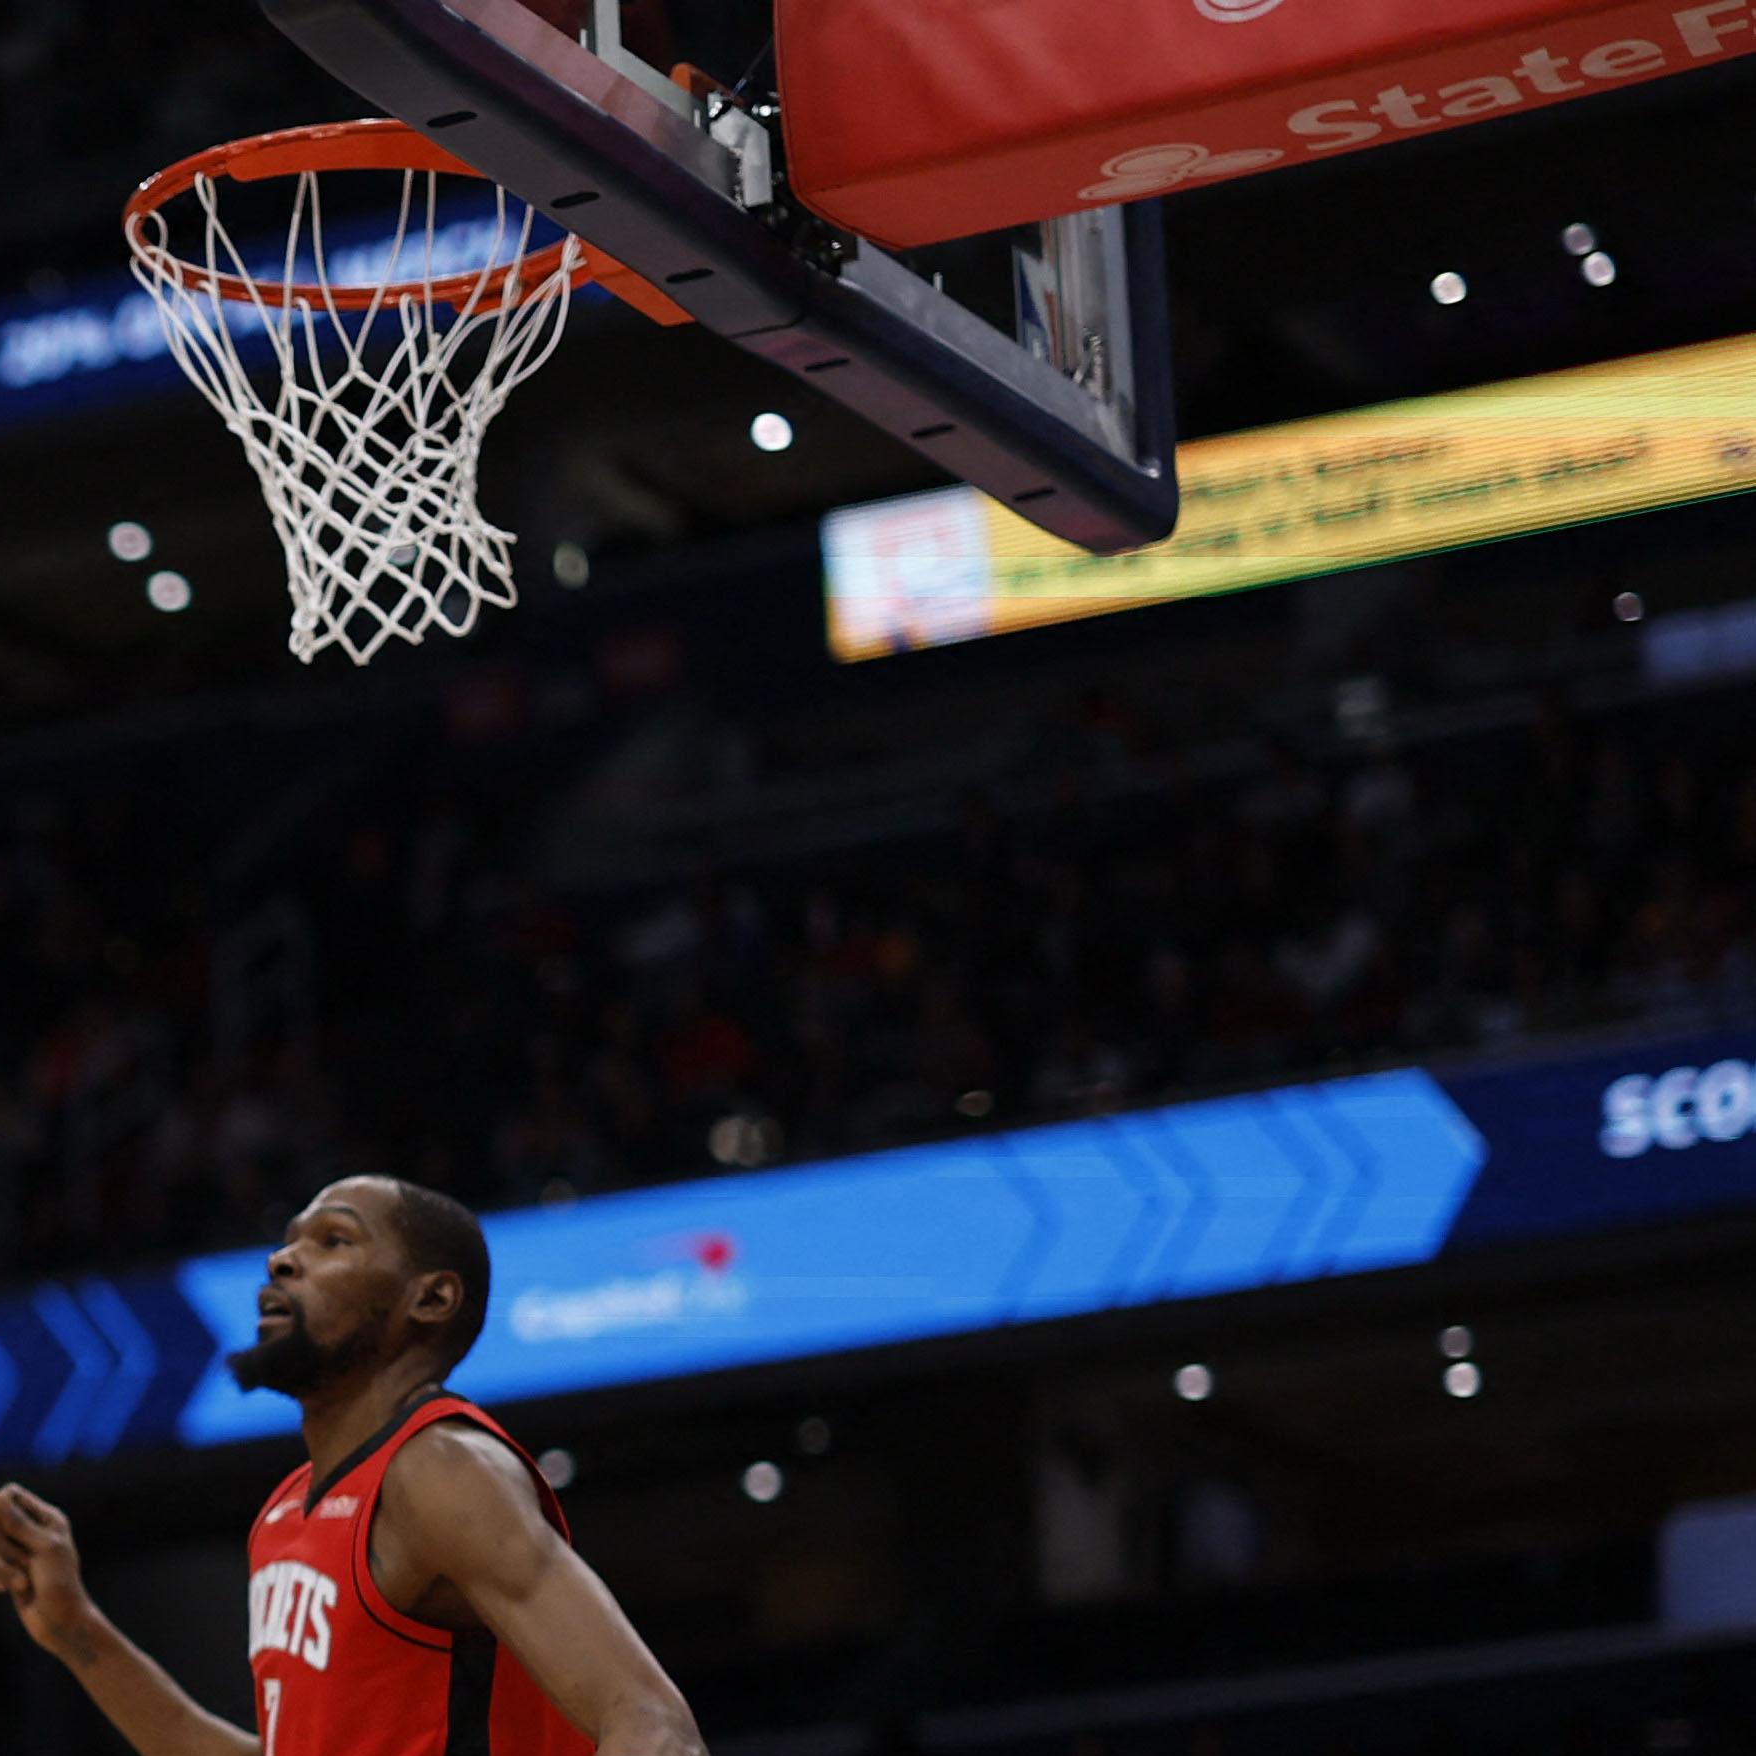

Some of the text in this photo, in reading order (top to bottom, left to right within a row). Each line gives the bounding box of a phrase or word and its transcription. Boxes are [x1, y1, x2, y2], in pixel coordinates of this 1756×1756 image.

[1287, 0, 1756, 151] State F
[1599, 1059, 1756, 1158] SCO
